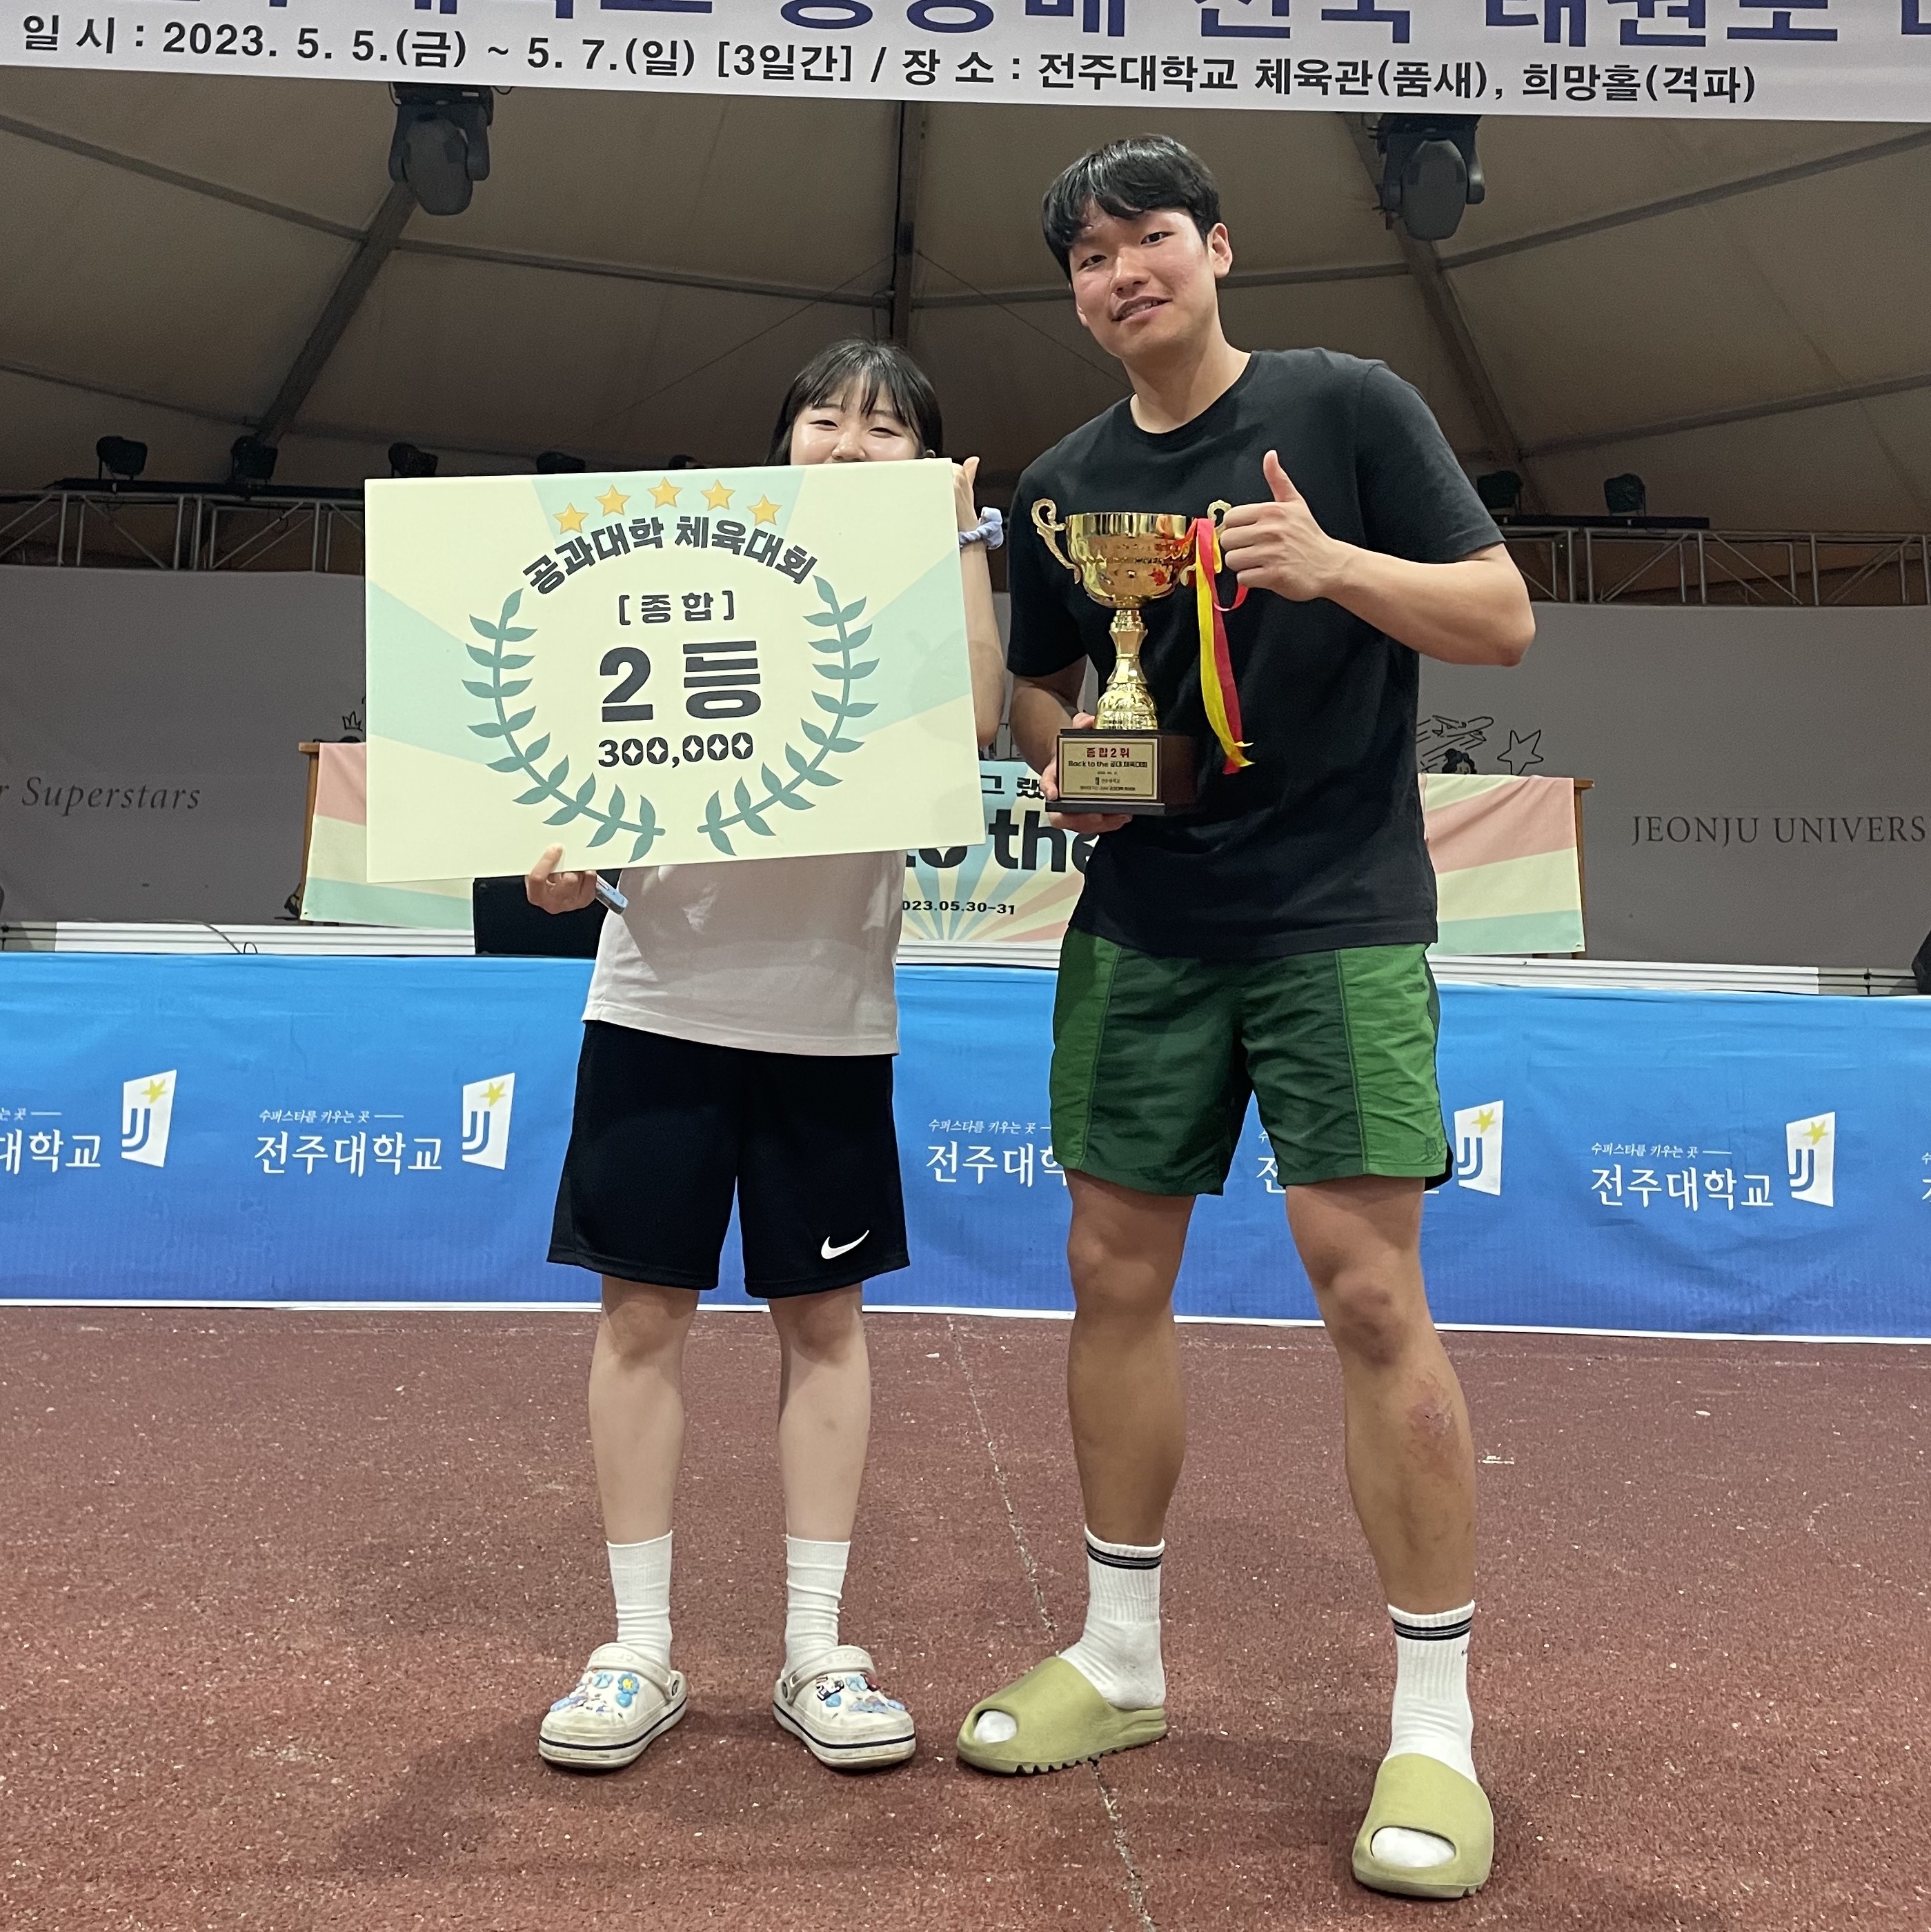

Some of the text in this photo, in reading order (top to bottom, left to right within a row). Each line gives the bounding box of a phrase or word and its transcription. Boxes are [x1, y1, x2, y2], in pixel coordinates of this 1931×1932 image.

[164, 22, 277, 57] 2023.
[719, 41, 851, 82] [3일간]
[1039, 52, 1238, 92] 전주대학교
[1254, 59, 1503, 100] 체육관(품새),
[1522, 64, 1755, 103] 희망홀(격파)
[522, 515, 818, 595] 공과대학 체육대회
[598, 732, 753, 769] 300,000
[21, 776, 201, 817] Superstars
[1632, 815, 1926, 848] JEONJU UNIVERS
[254, 1131, 442, 1177] 전주대학교
[1591, 1164, 1774, 1211] 전주대학교
